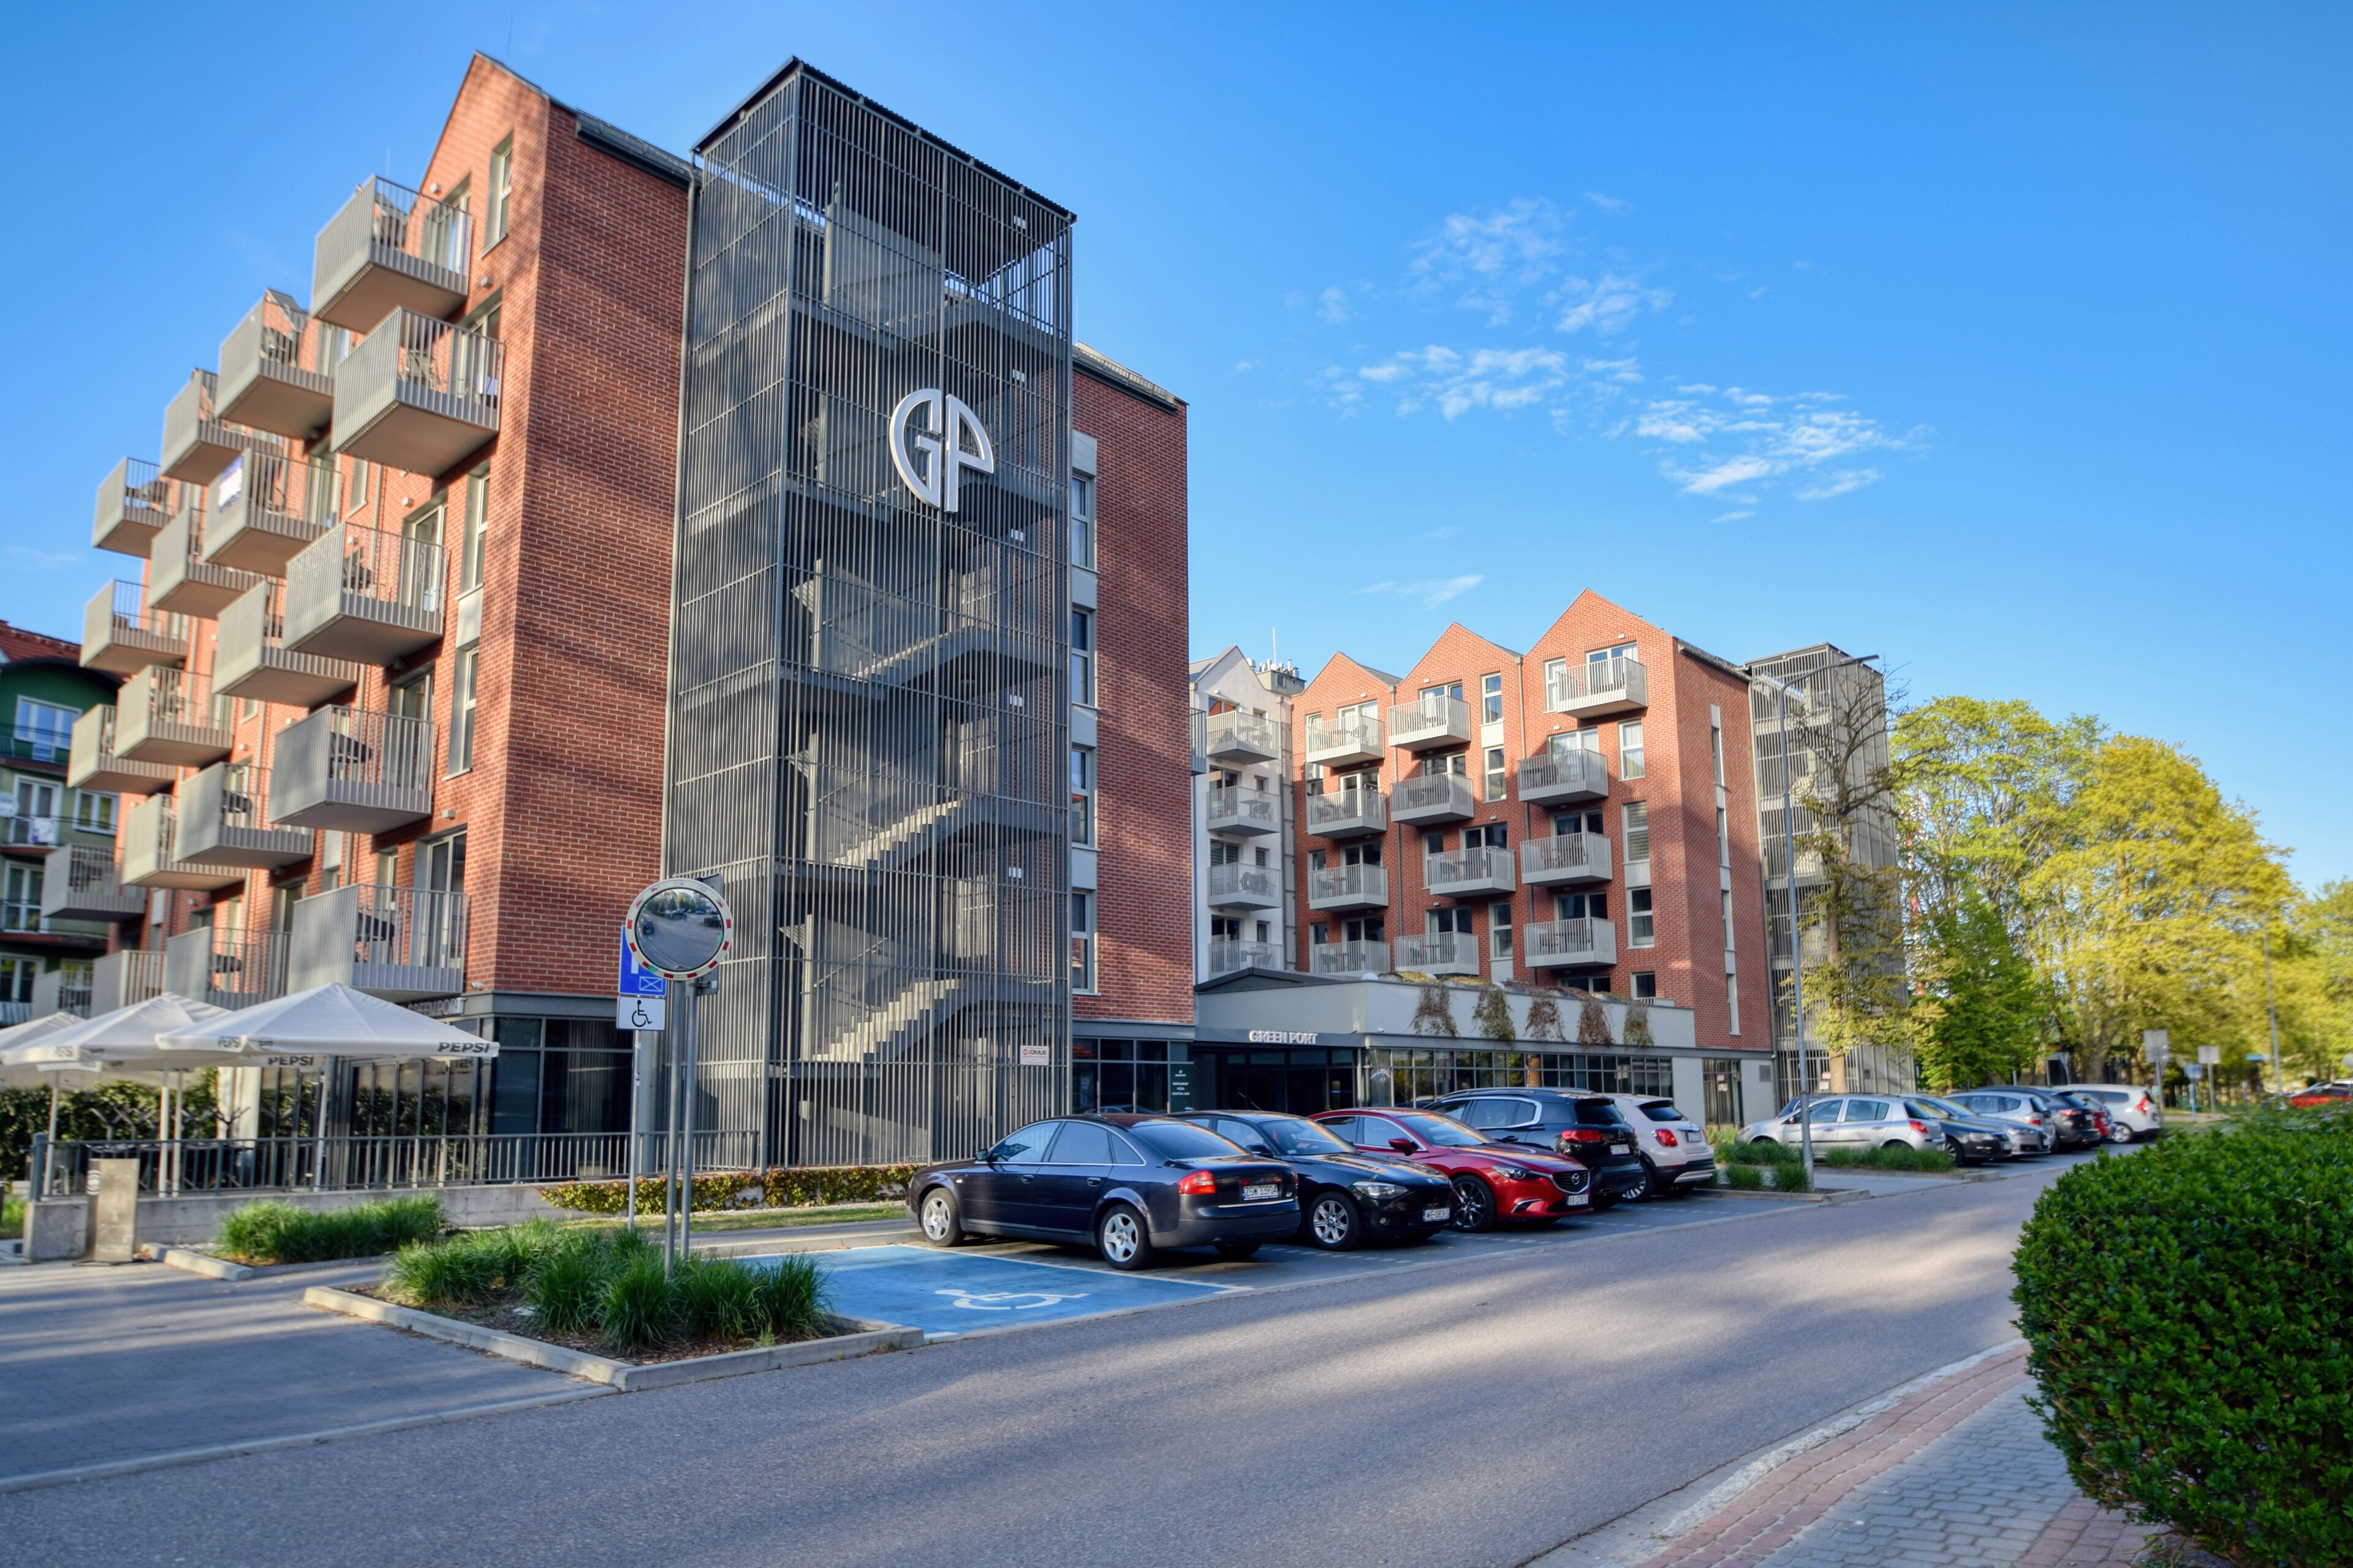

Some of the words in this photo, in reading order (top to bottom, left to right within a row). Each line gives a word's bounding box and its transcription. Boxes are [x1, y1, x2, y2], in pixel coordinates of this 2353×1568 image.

[1249, 1030, 1287, 1043] GREEN
[1289, 1031, 1318, 1045] PORT
[437, 1042, 491, 1053] PEPSI
[268, 1056, 314, 1066] PEPSI
